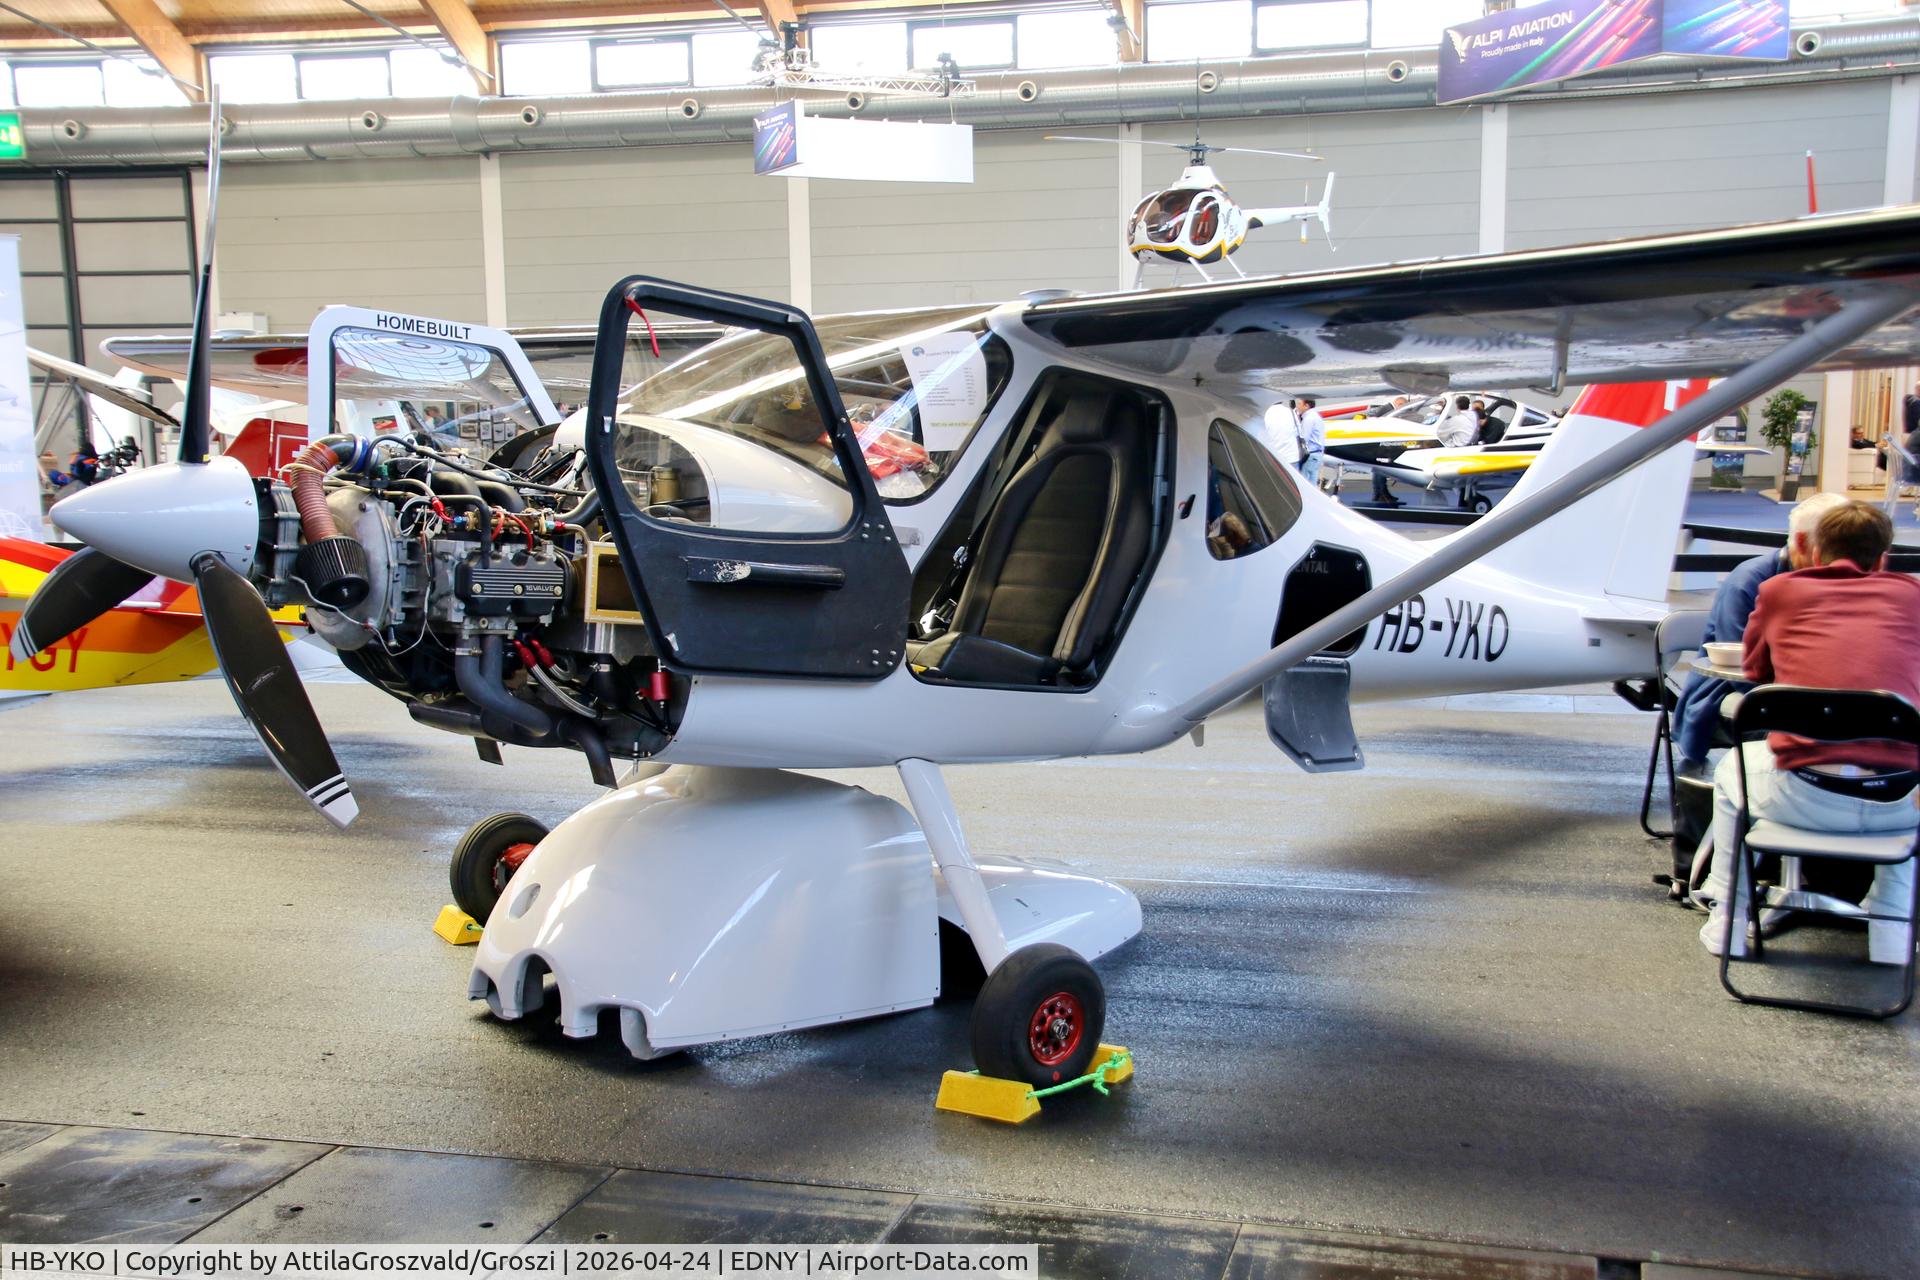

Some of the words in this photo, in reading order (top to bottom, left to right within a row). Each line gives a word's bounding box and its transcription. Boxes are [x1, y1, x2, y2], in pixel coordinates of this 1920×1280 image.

[1472, 28, 1503, 48] ALPI
[1508, 10, 1573, 40] AVIATION
[1481, 46, 1504, 59] Proudly
[1504, 43, 1522, 53] made
[1529, 37, 1545, 47] Italy
[377, 314, 472, 340] HOMEBUILT
[1373, 593, 1509, 662] HB-YKO
